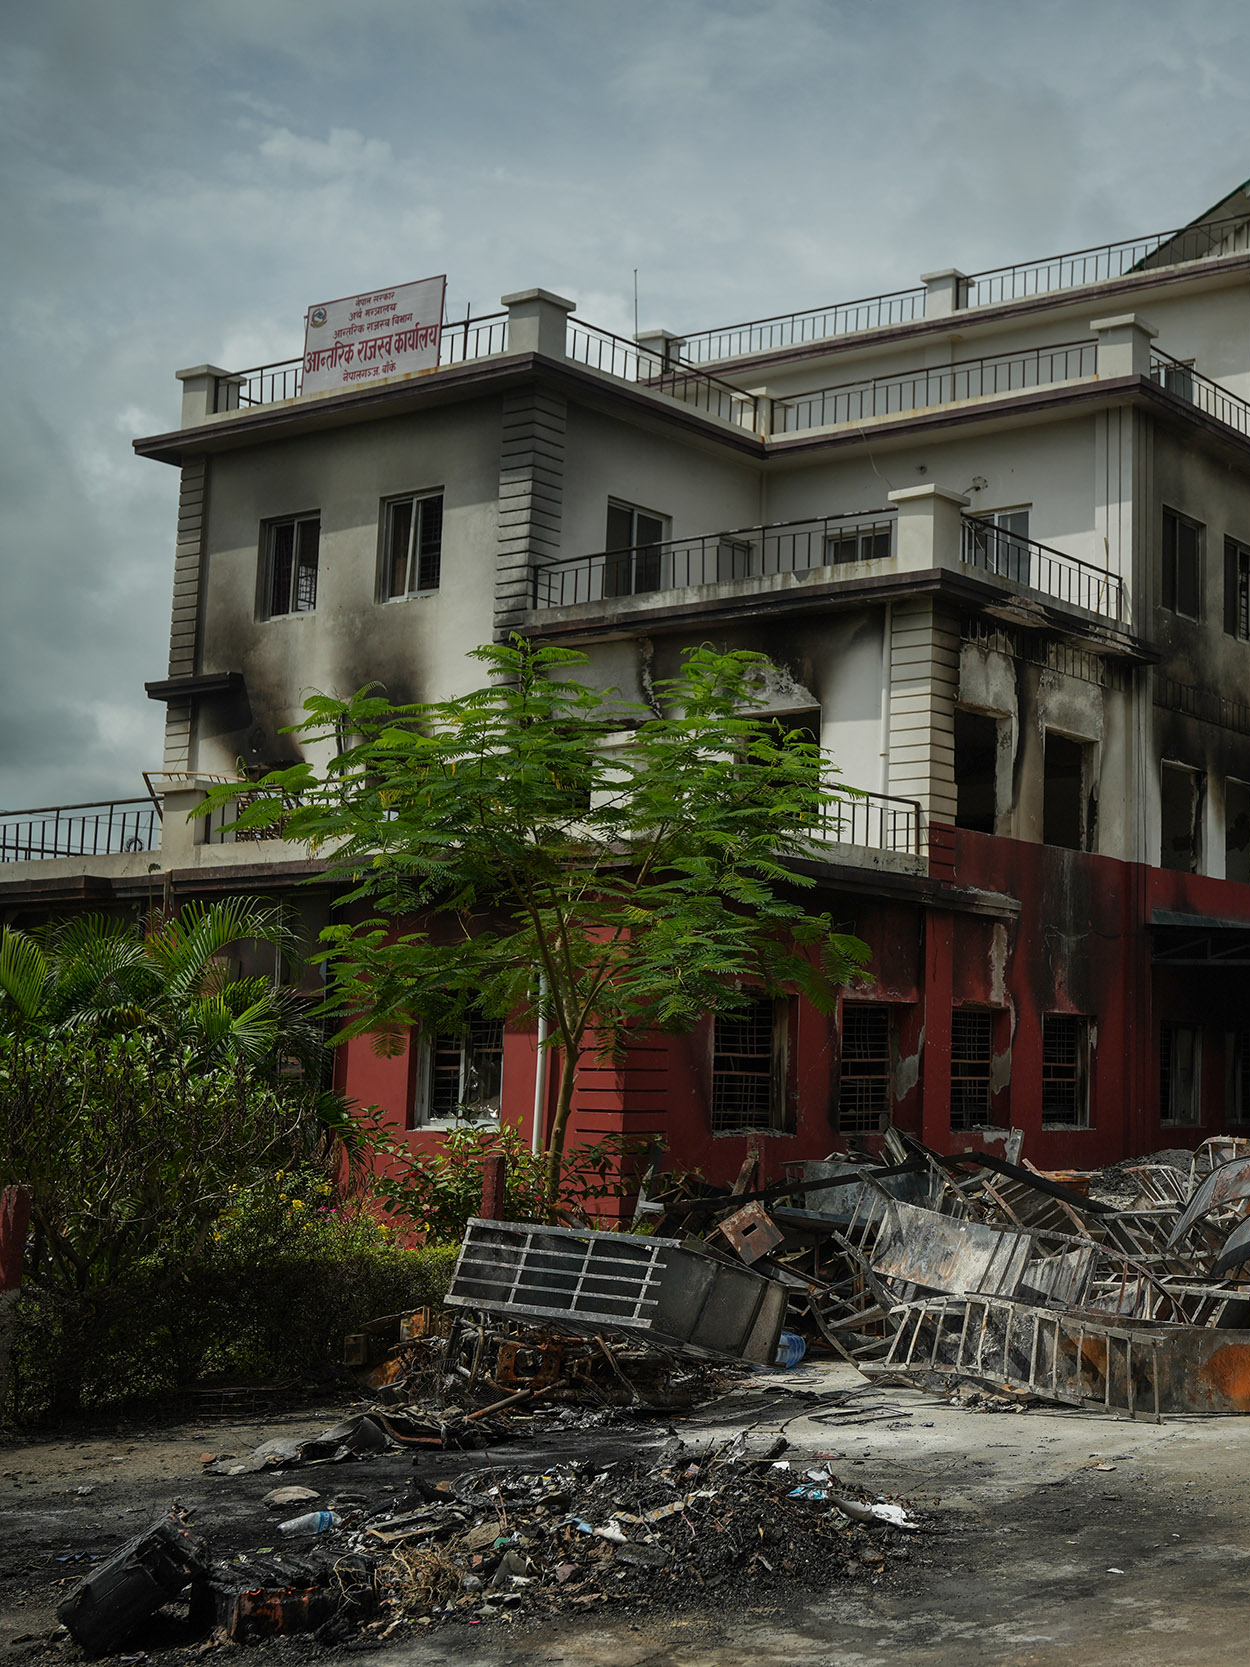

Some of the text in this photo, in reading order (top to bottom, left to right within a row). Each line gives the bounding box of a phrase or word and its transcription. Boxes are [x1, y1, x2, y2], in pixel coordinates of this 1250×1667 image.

[365, 303, 397, 316] मन्त्रालय
[333, 312, 413, 339] आन्तरिक राजस्व विभाग
[305, 322, 439, 373] आन्तरिक राजस्व कार्यालय
